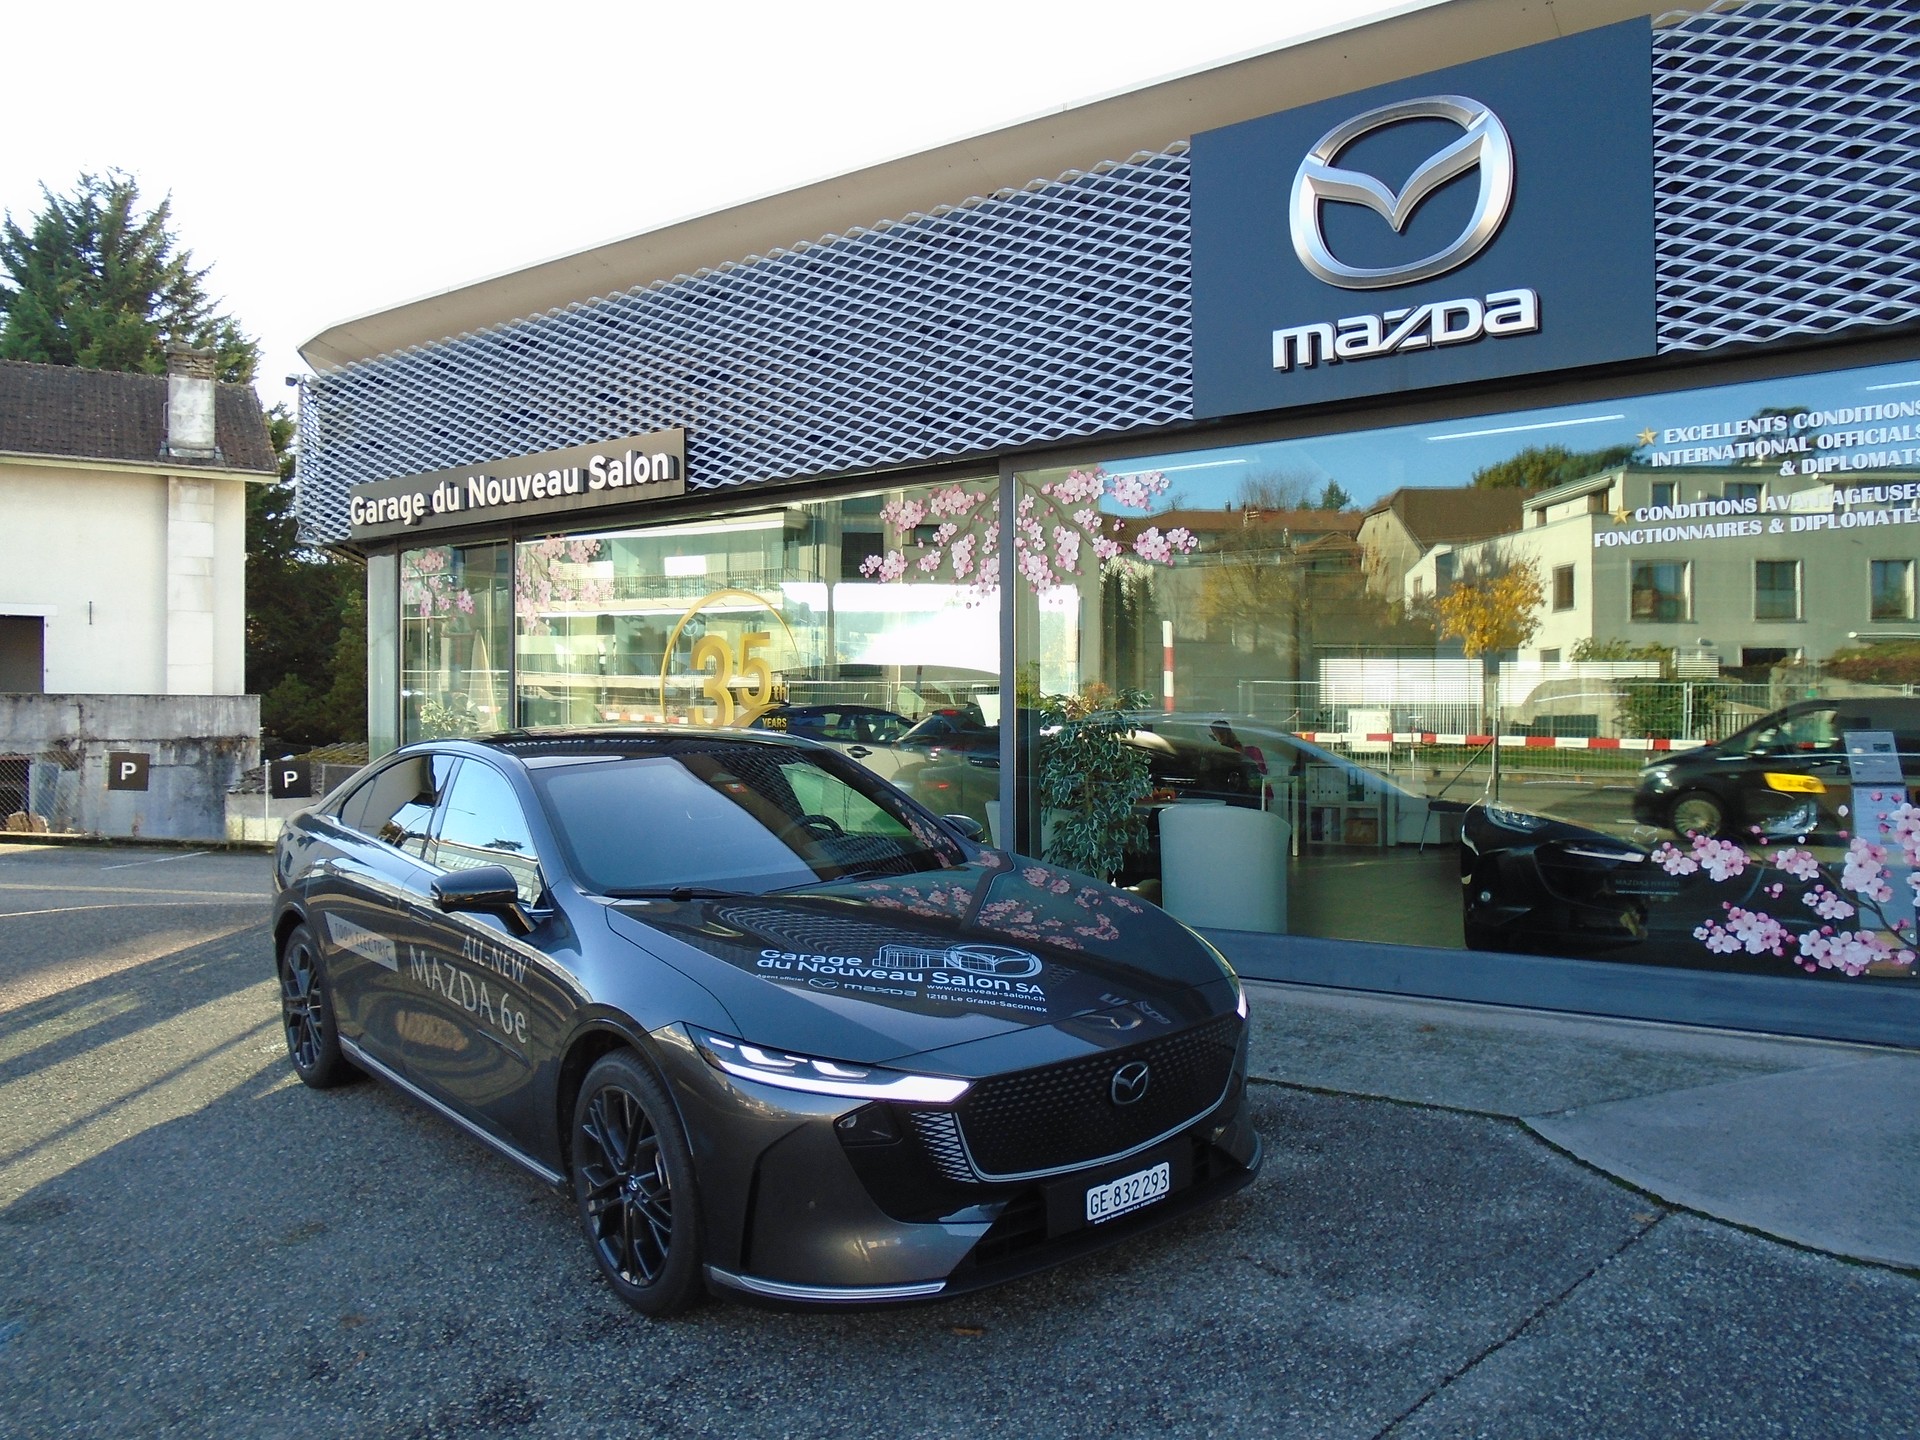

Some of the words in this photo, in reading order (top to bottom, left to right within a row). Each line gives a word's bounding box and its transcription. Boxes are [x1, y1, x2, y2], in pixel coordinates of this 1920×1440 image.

[1273, 287, 1538, 370] mazda
[1664, 415, 1787, 444] EXCELLENTS
[1651, 437, 1812, 467] INTERNATIONAL
[1779, 459, 1796, 477] &
[350, 493, 425, 526] Garage
[432, 480, 460, 512] du
[468, 466, 580, 509] Nouveau
[588, 449, 671, 490] Salon
[1635, 498, 1757, 522] CONDITIONS
[1764, 482, 1920, 511] AVANTAGEUSE
[1594, 519, 1762, 548] FONCTIONNAIRES
[1768, 517, 1785, 534] &
[1791, 507, 1920, 532] DIPLOMATE
[762, 717, 787, 728] YEARS
[121, 762, 137, 781] P
[283, 770, 298, 789] P
[461, 935, 530, 984] ALL-NEW
[760, 948, 862, 966] Garage
[757, 957, 791, 970] du
[798, 960, 923, 984] Nouveau
[932, 971, 1010, 991] Salon
[1016, 982, 1045, 995] SA
[844, 983, 917, 998] mazda
[409, 945, 496, 1026] MAZDA
[500, 993, 529, 1044] 6e
[926, 993, 948, 1001] 1218
[966, 996, 1048, 1013] Grand-Saconnex
[927, 984, 1046, 1002] www.nouveau-salon.ch
